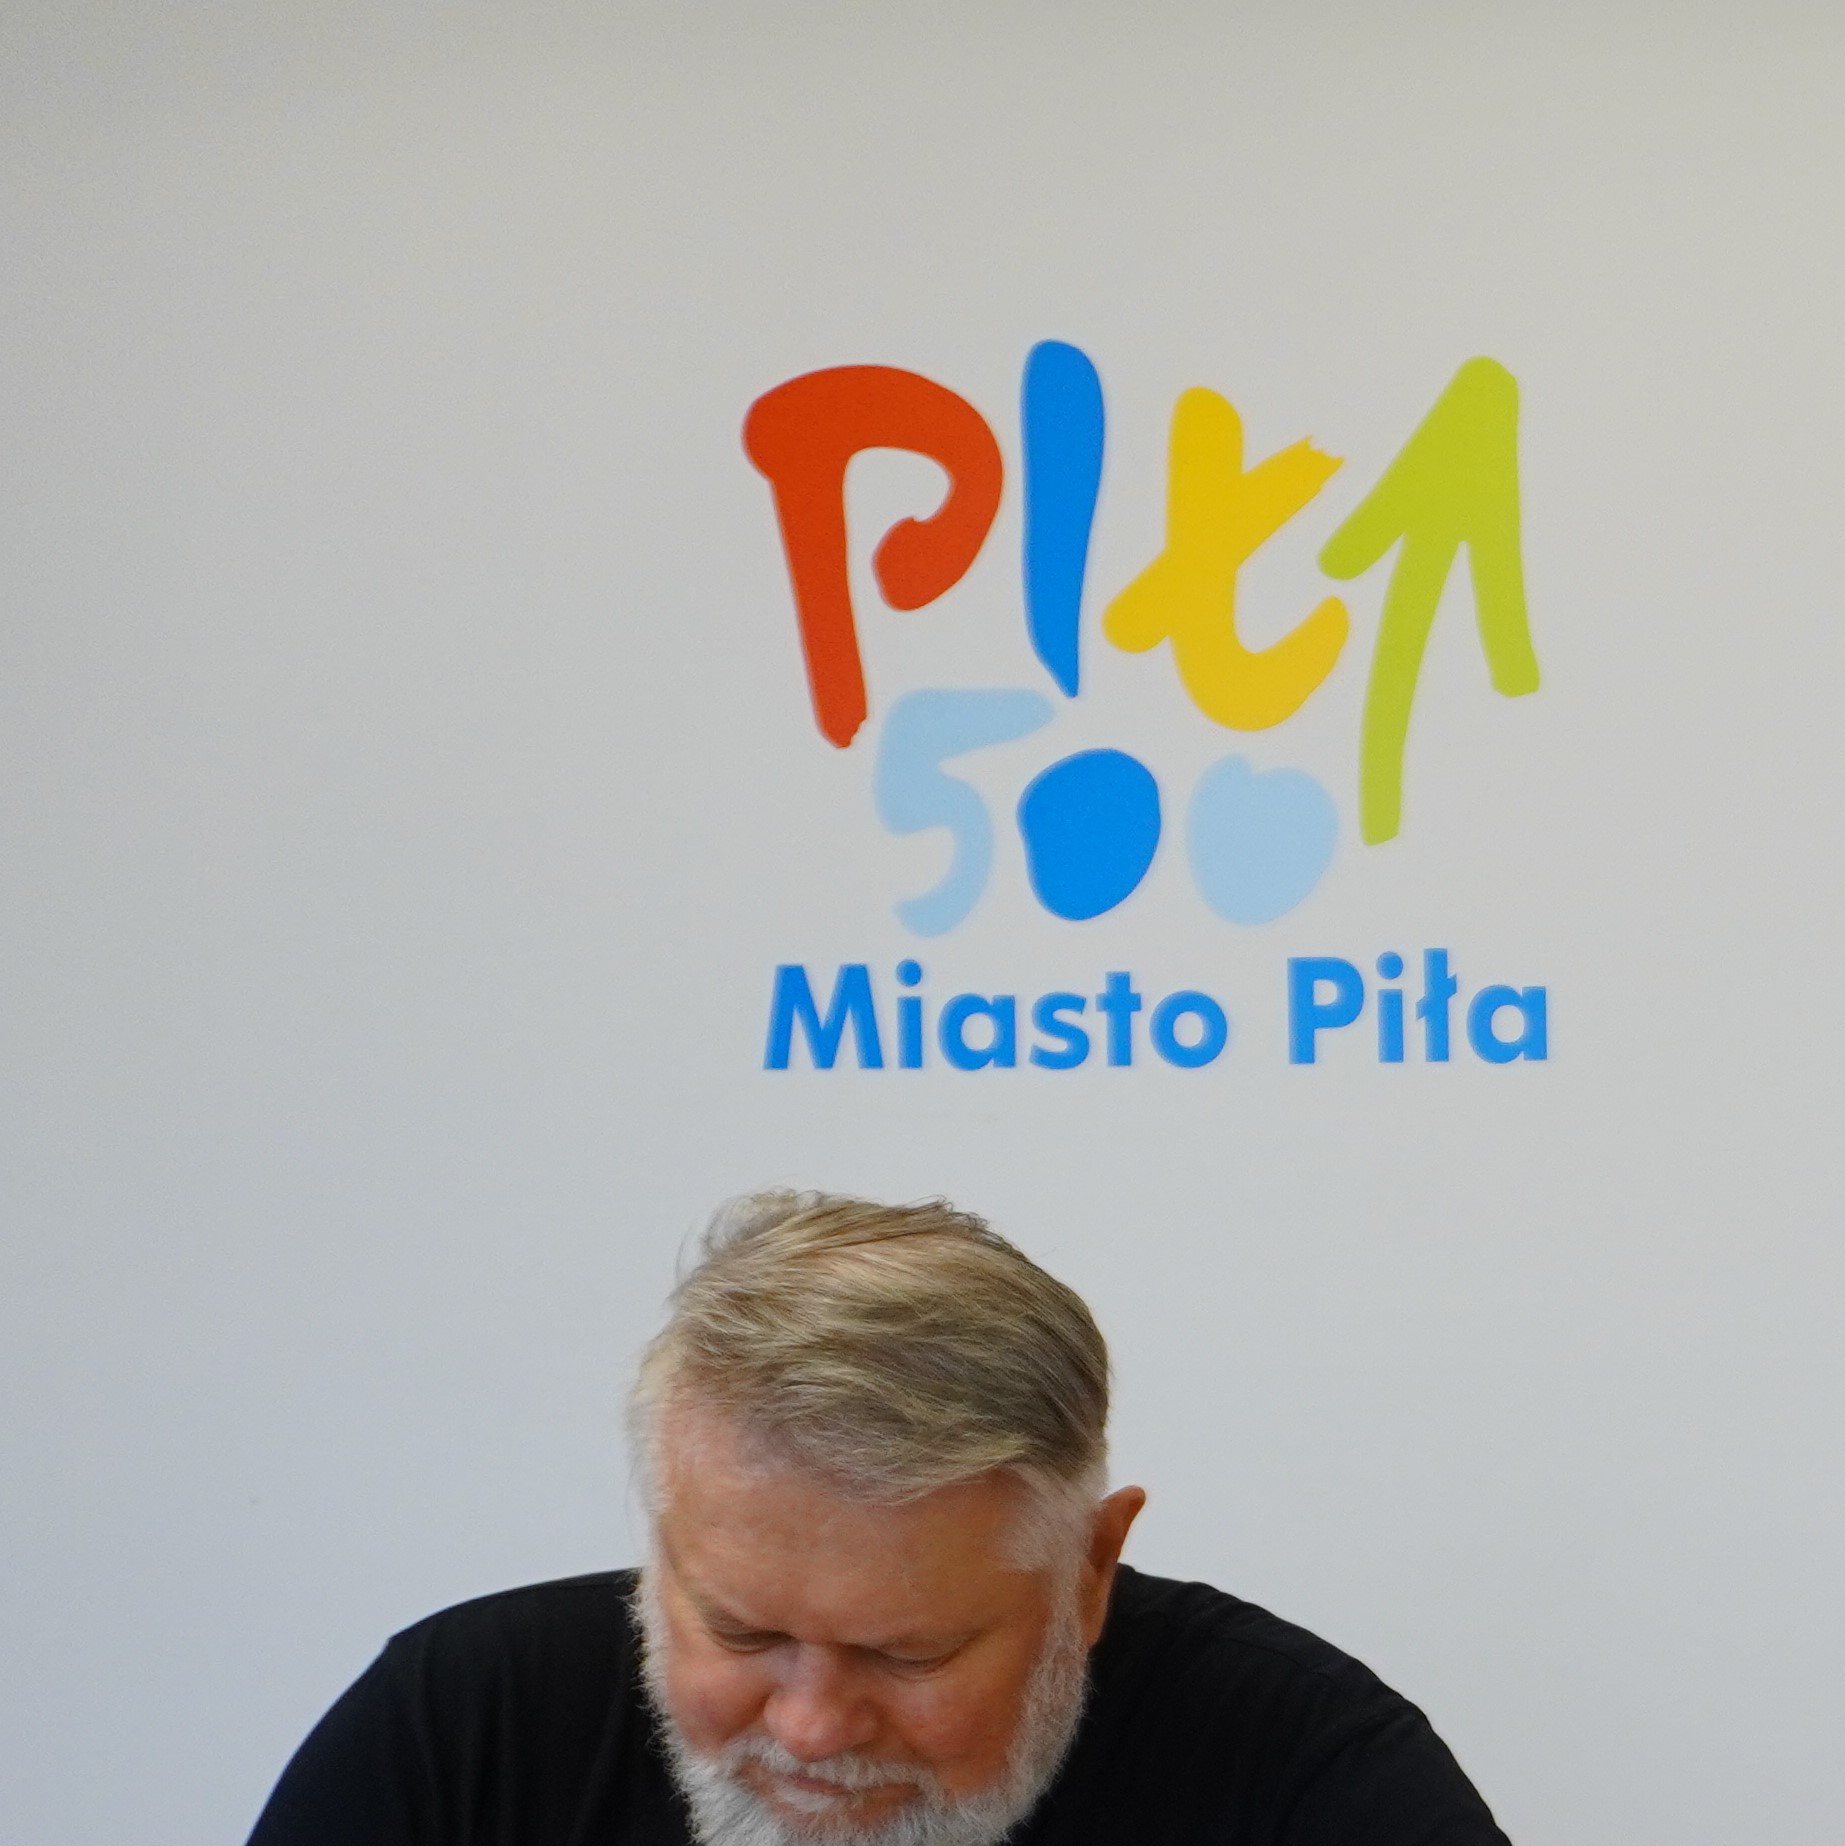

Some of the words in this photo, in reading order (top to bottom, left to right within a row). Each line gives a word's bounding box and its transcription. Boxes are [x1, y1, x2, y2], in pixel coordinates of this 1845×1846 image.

[873, 688, 1339, 938] 500
[763, 960, 1228, 1071] Miasto
[1287, 948, 1549, 1065] Piła
